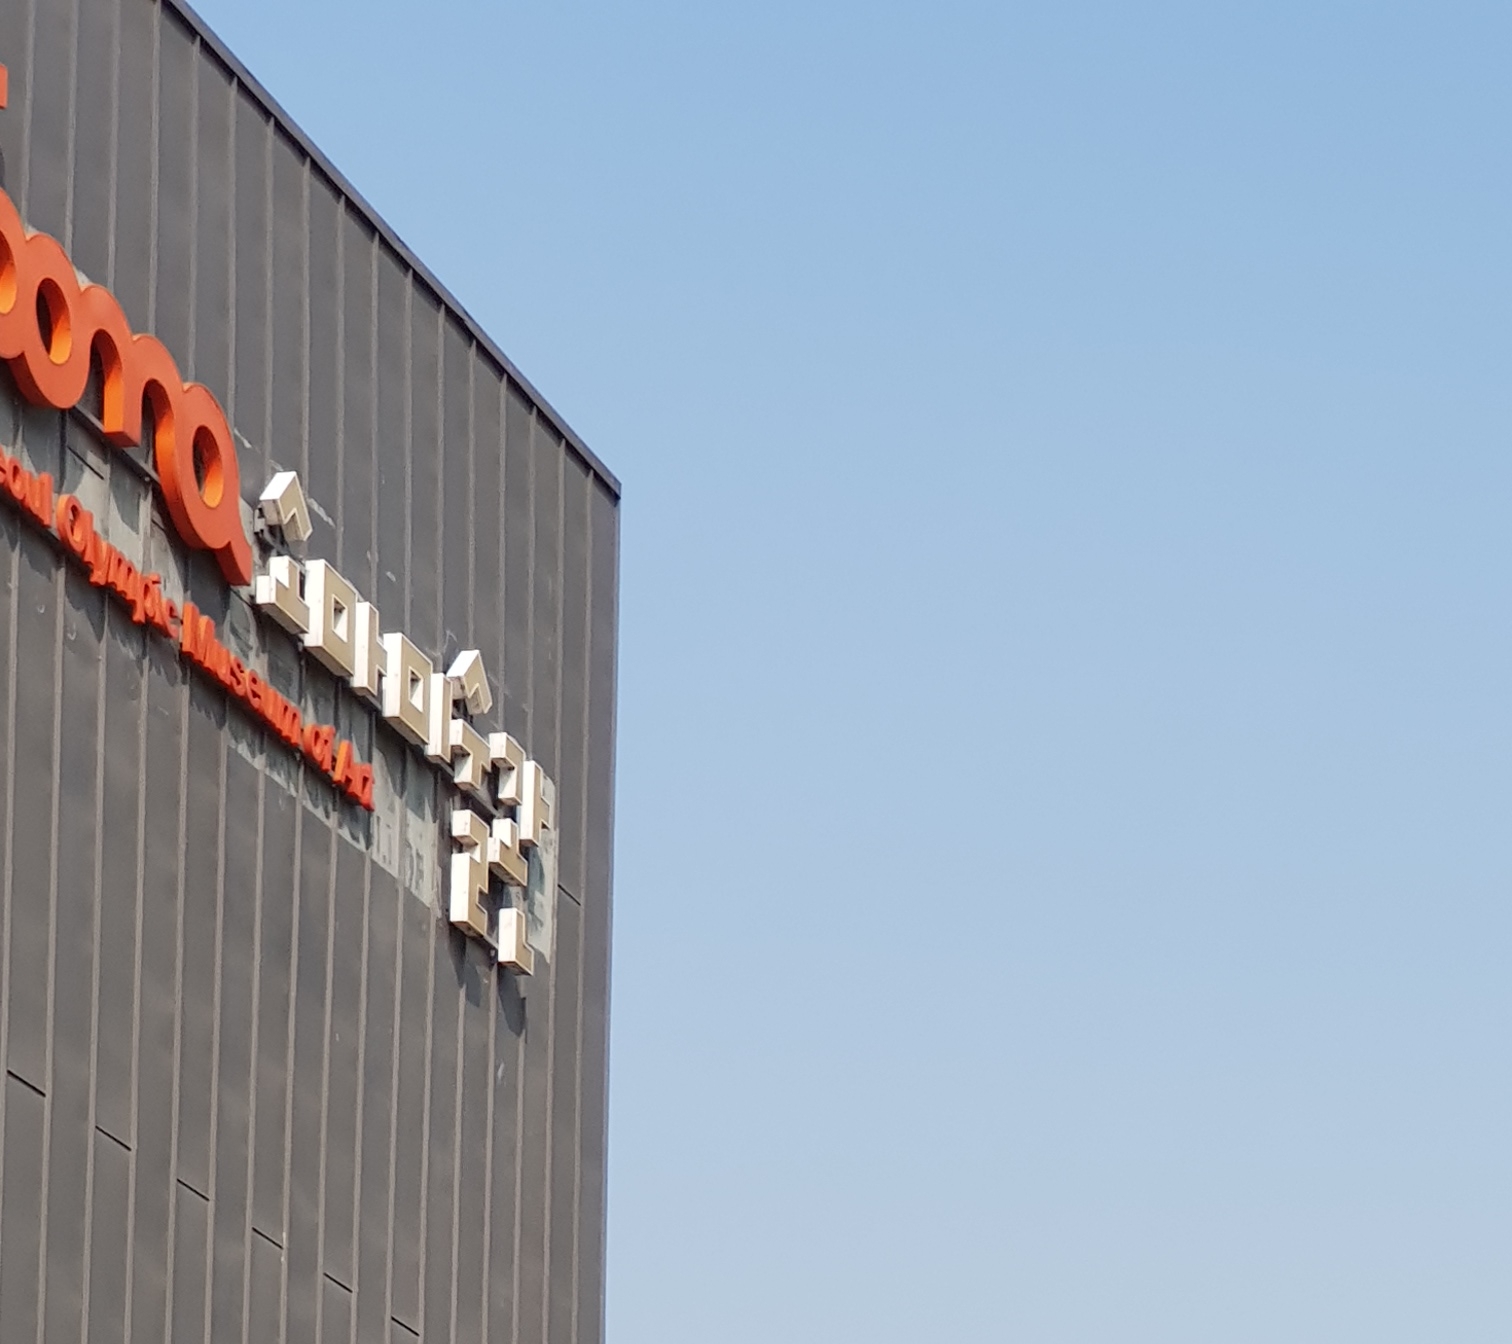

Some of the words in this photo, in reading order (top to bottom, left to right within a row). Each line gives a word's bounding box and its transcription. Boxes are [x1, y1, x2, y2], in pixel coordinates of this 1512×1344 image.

[56, 494, 178, 639] Olympic
[181, 602, 303, 747] Museum
[303, 723, 336, 772] of
[332, 739, 374, 811] Art
[256, 471, 550, 976] 소마미술관
